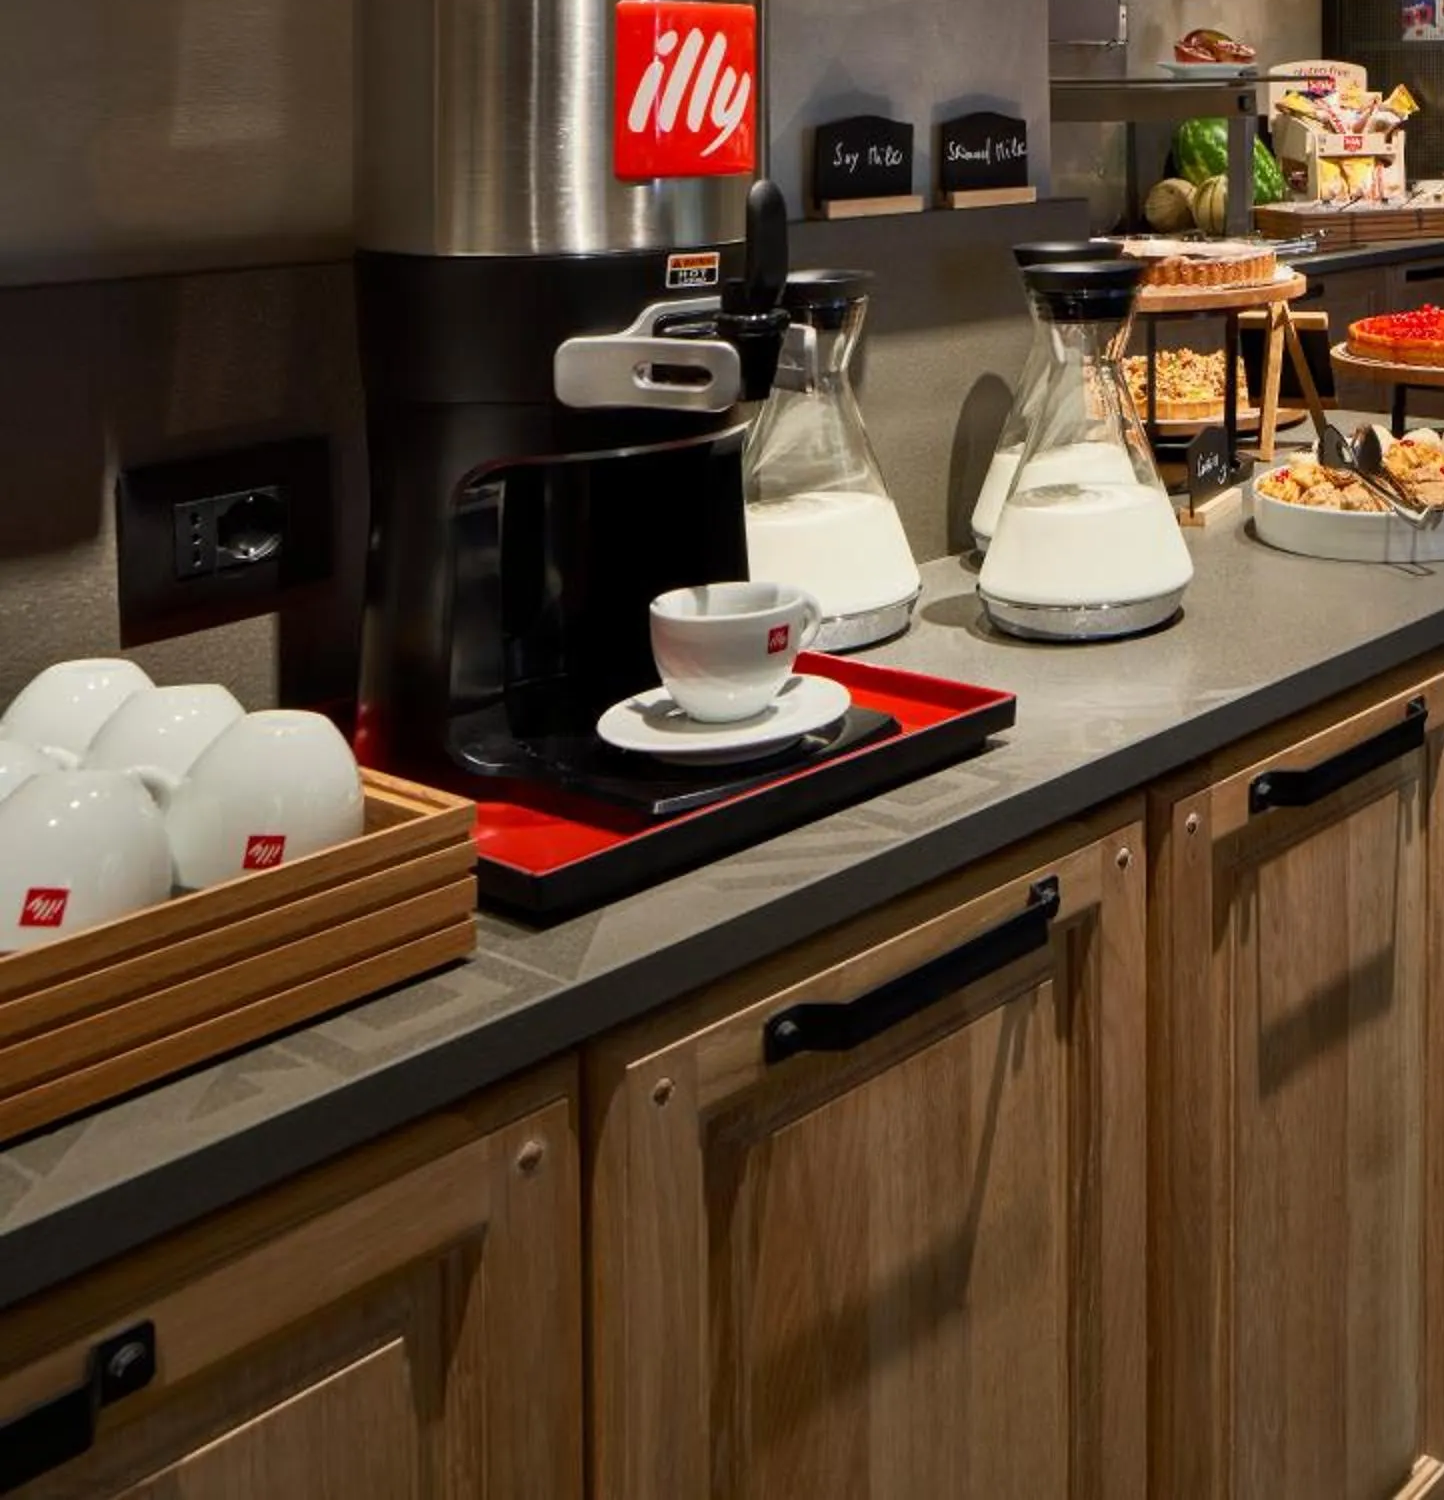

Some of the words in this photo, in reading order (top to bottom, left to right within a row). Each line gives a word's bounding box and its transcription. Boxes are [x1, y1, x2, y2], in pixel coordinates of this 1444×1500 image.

[628, 27, 751, 157] illy
[833, 142, 860, 173] Soy
[248, 840, 281, 864] illy
[27, 894, 64, 920] illy
